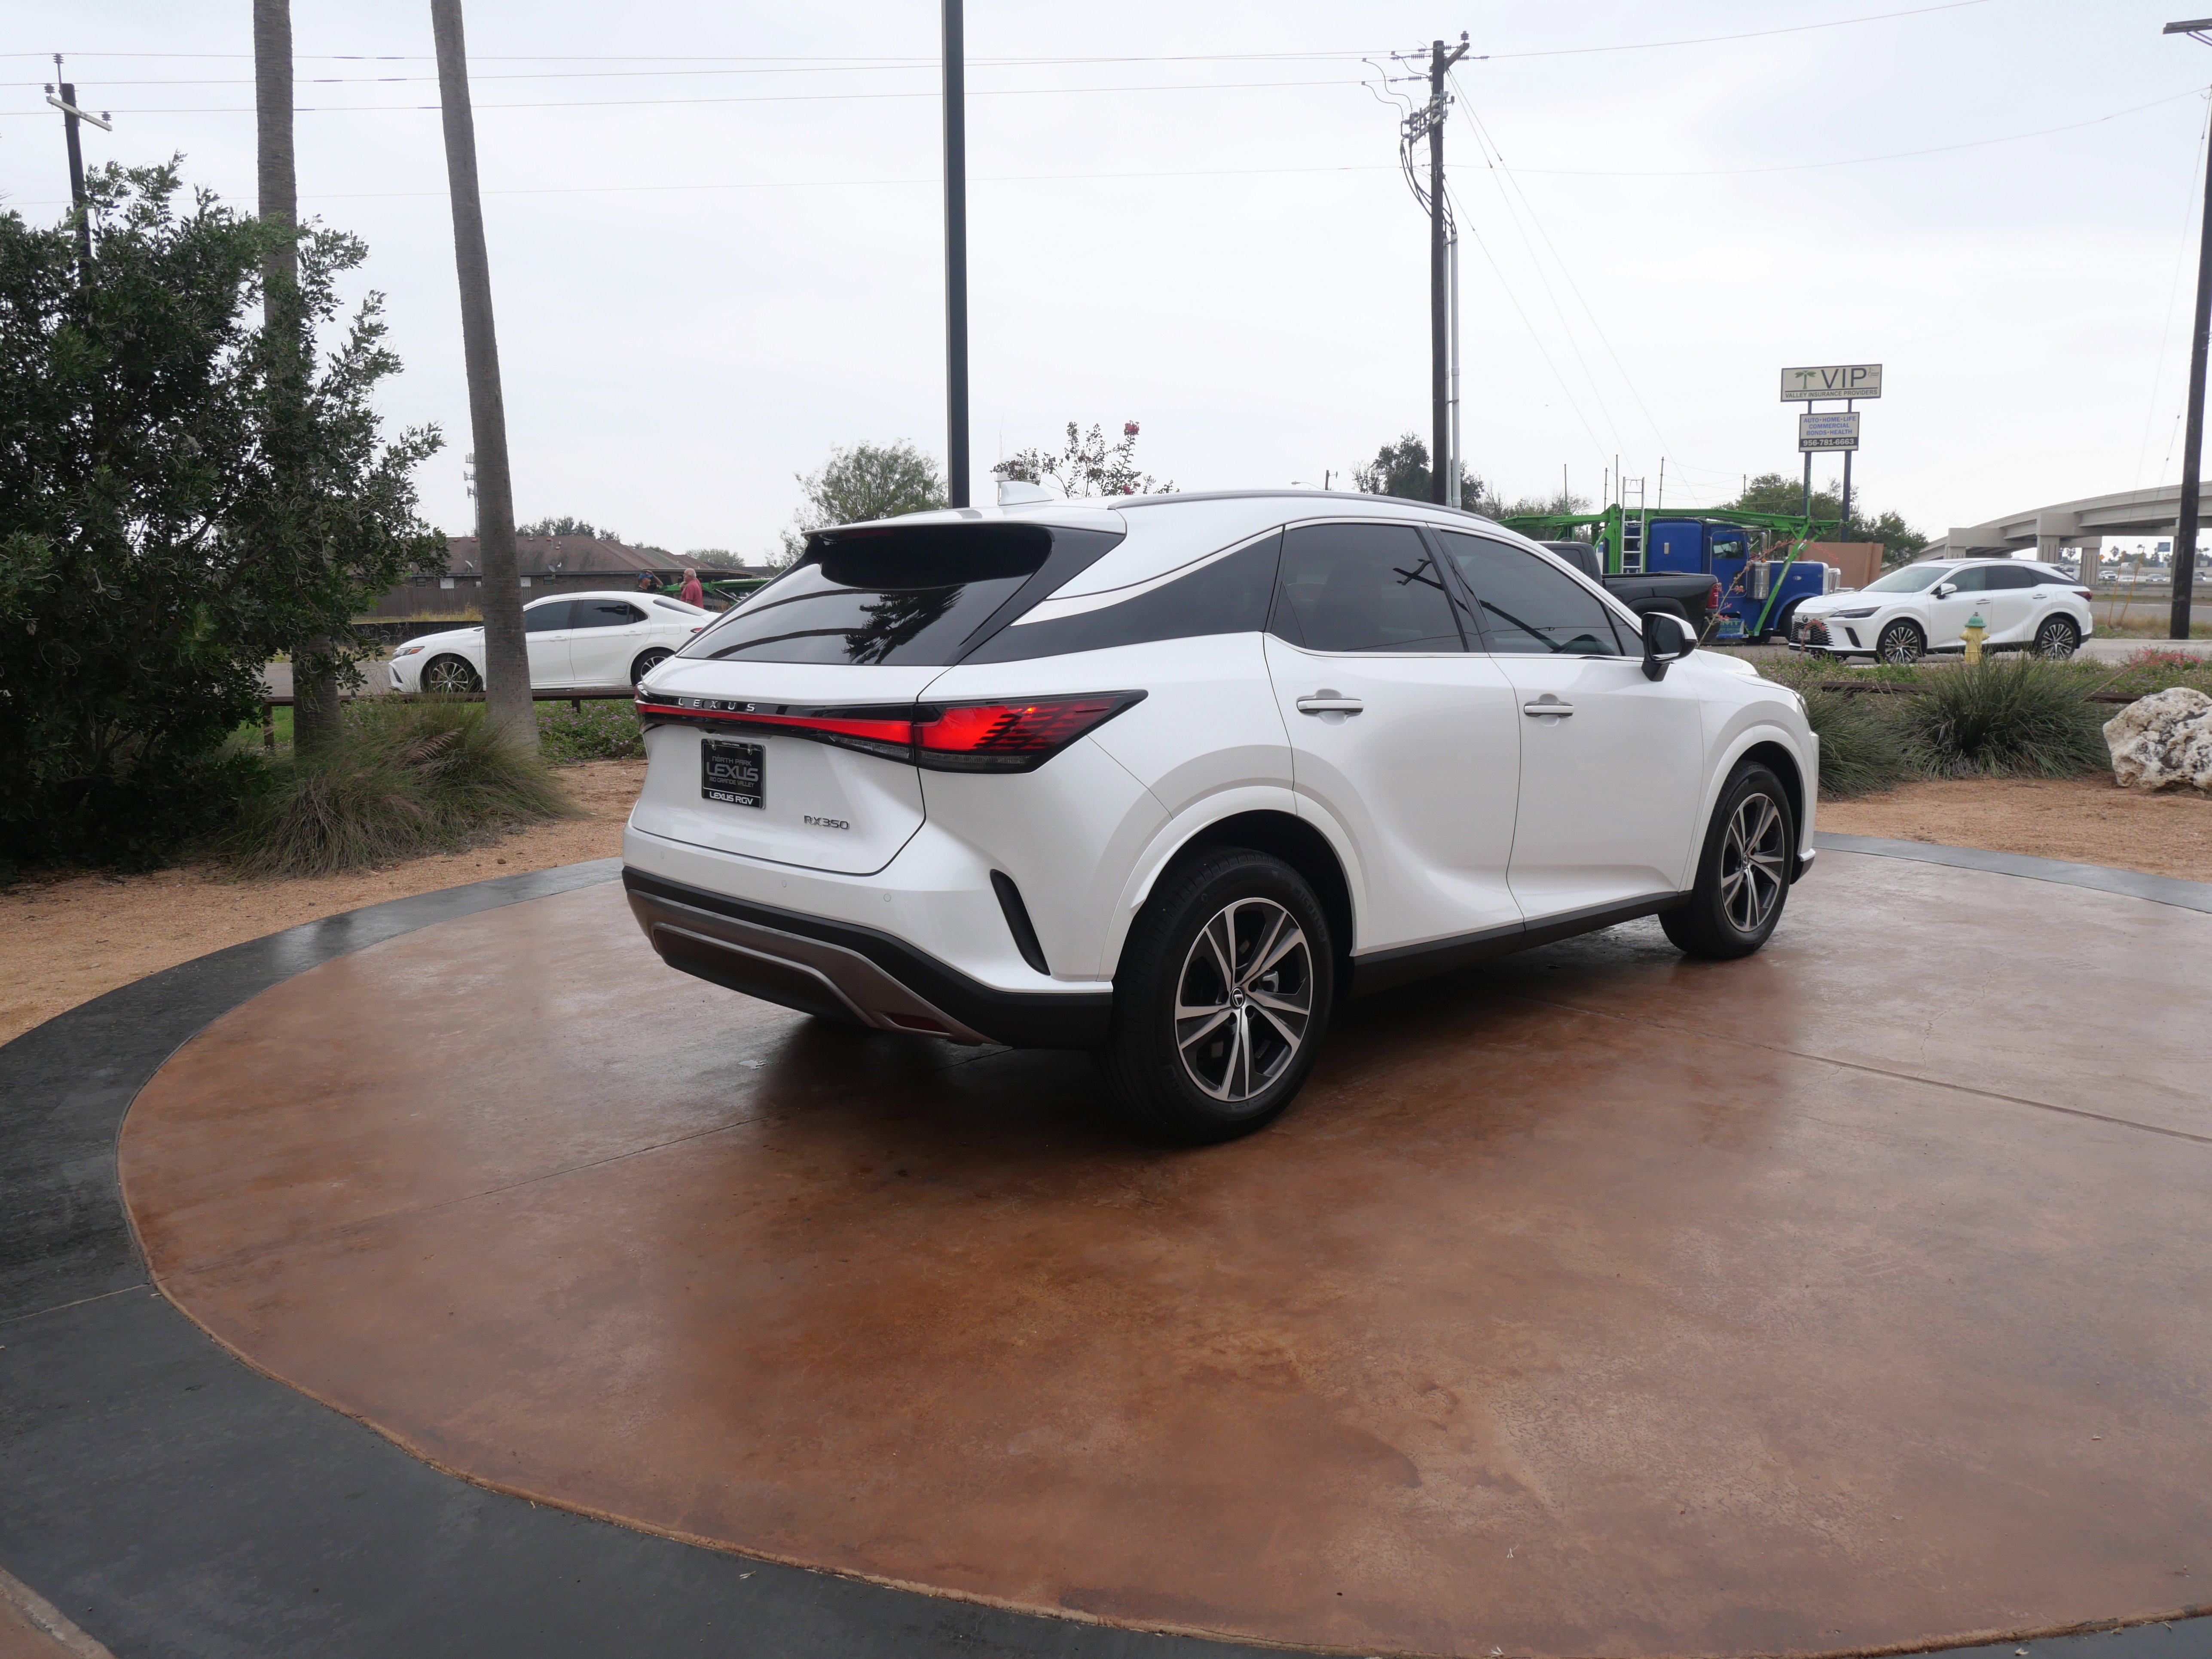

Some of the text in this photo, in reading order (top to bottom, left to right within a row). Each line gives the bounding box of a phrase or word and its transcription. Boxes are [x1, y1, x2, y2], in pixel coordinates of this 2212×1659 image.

[1821, 367, 1867, 389] VIP
[678, 698, 756, 712] LEXUS
[707, 762, 758, 782] LEXUS
[709, 791, 753, 805] LEXUS RGV
[804, 815, 850, 830] RX350
